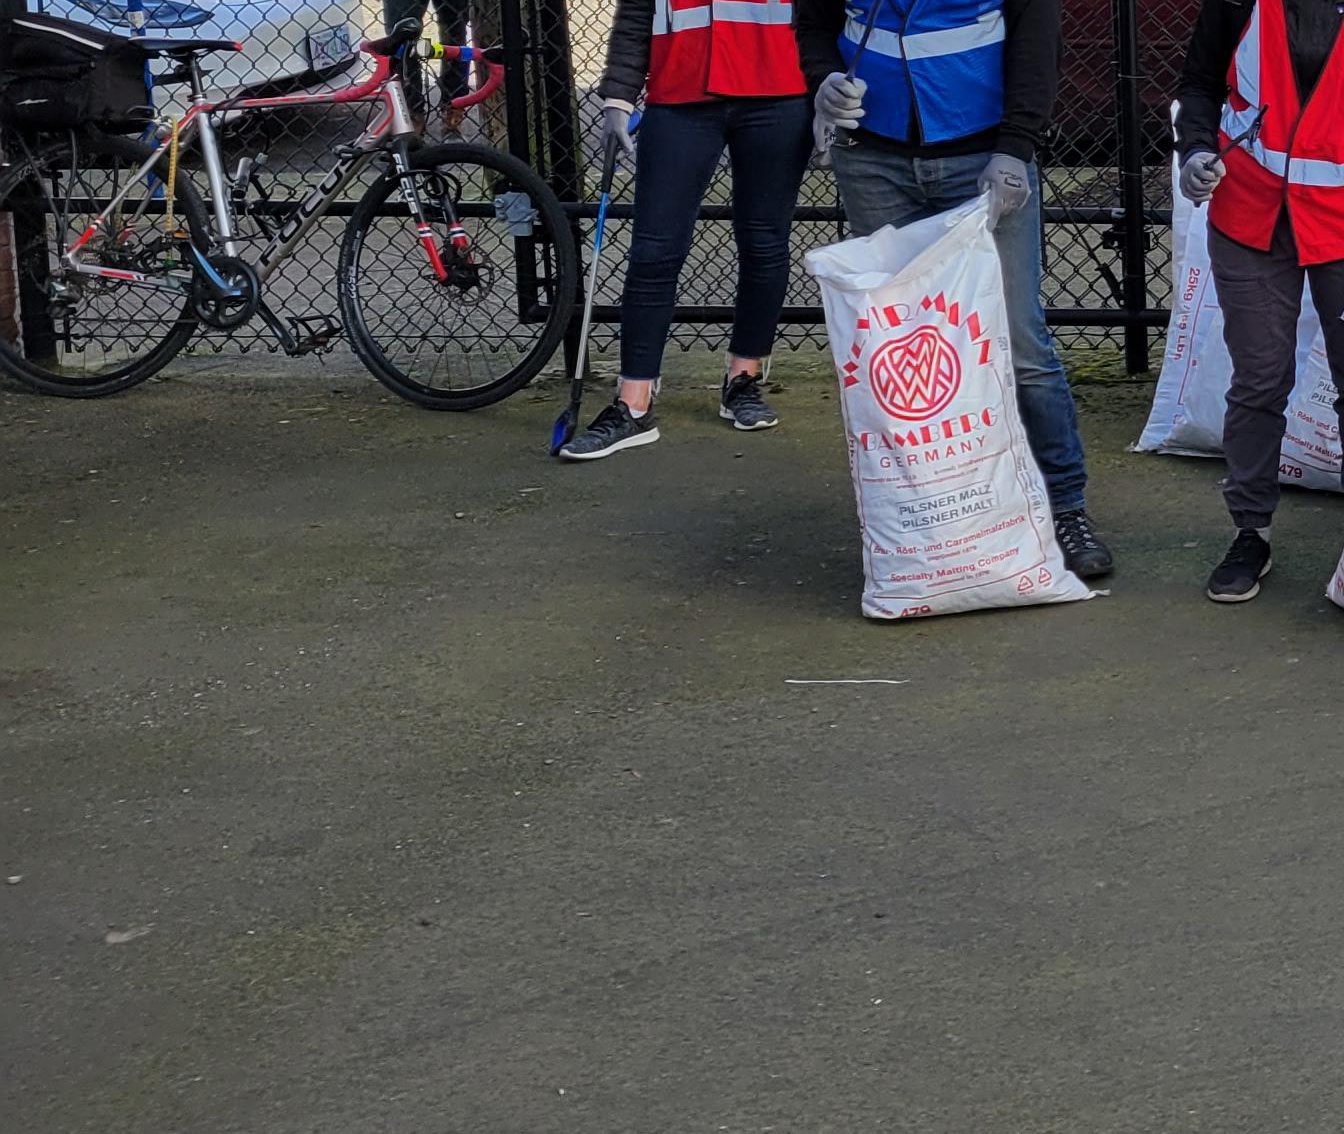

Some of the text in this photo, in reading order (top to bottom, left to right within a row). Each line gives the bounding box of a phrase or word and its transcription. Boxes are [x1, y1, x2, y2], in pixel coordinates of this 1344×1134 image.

[860, 406, 998, 452] BAMBERG
[879, 435, 986, 469] GERMANY
[899, 484, 993, 516] PILSNER MALZ
[901, 499, 996, 530] PILSNER MALT
[924, 542, 943, 553] und
[945, 515, 1026, 548] Caramelmalzfabrik
[890, 569, 934, 583] Specialty
[936, 562, 977, 577] Malting
[978, 546, 1020, 568] Company
